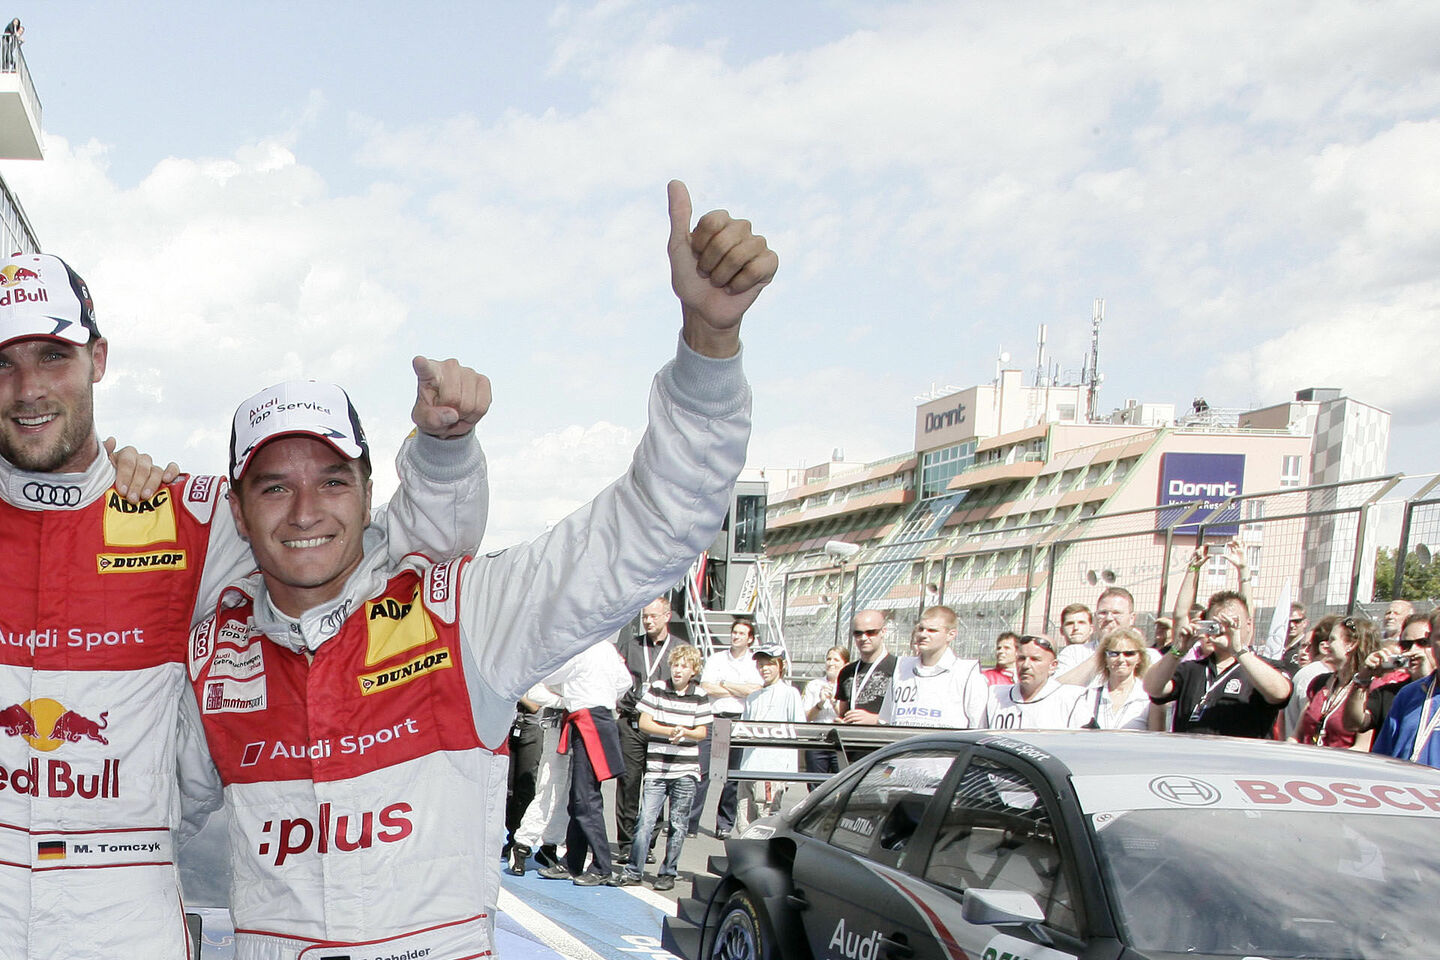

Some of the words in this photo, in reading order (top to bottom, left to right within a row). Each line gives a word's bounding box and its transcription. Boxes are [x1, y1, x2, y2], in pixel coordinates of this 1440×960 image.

[14, 288, 48, 303] Bull
[249, 397, 280, 419] Audi
[925, 403, 966, 434] Dorint
[1168, 480, 1238, 497] Dorint
[108, 491, 168, 514] ADAC
[112, 554, 183, 568] DUNLOP
[66, 626, 144, 651] Sport
[376, 652, 448, 687] DUNLOP
[895, 684, 918, 703] 002
[896, 707, 942, 718] DMSB
[995, 711, 1023, 729] 001
[270, 739, 331, 760] Audi
[340, 718, 420, 755] Sport
[731, 724, 797, 739] Audi
[1015, 745, 1051, 762] Sport
[47, 758, 120, 799] Bull
[73, 845, 93, 854] M.
[97, 842, 161, 854] Tomczyk
